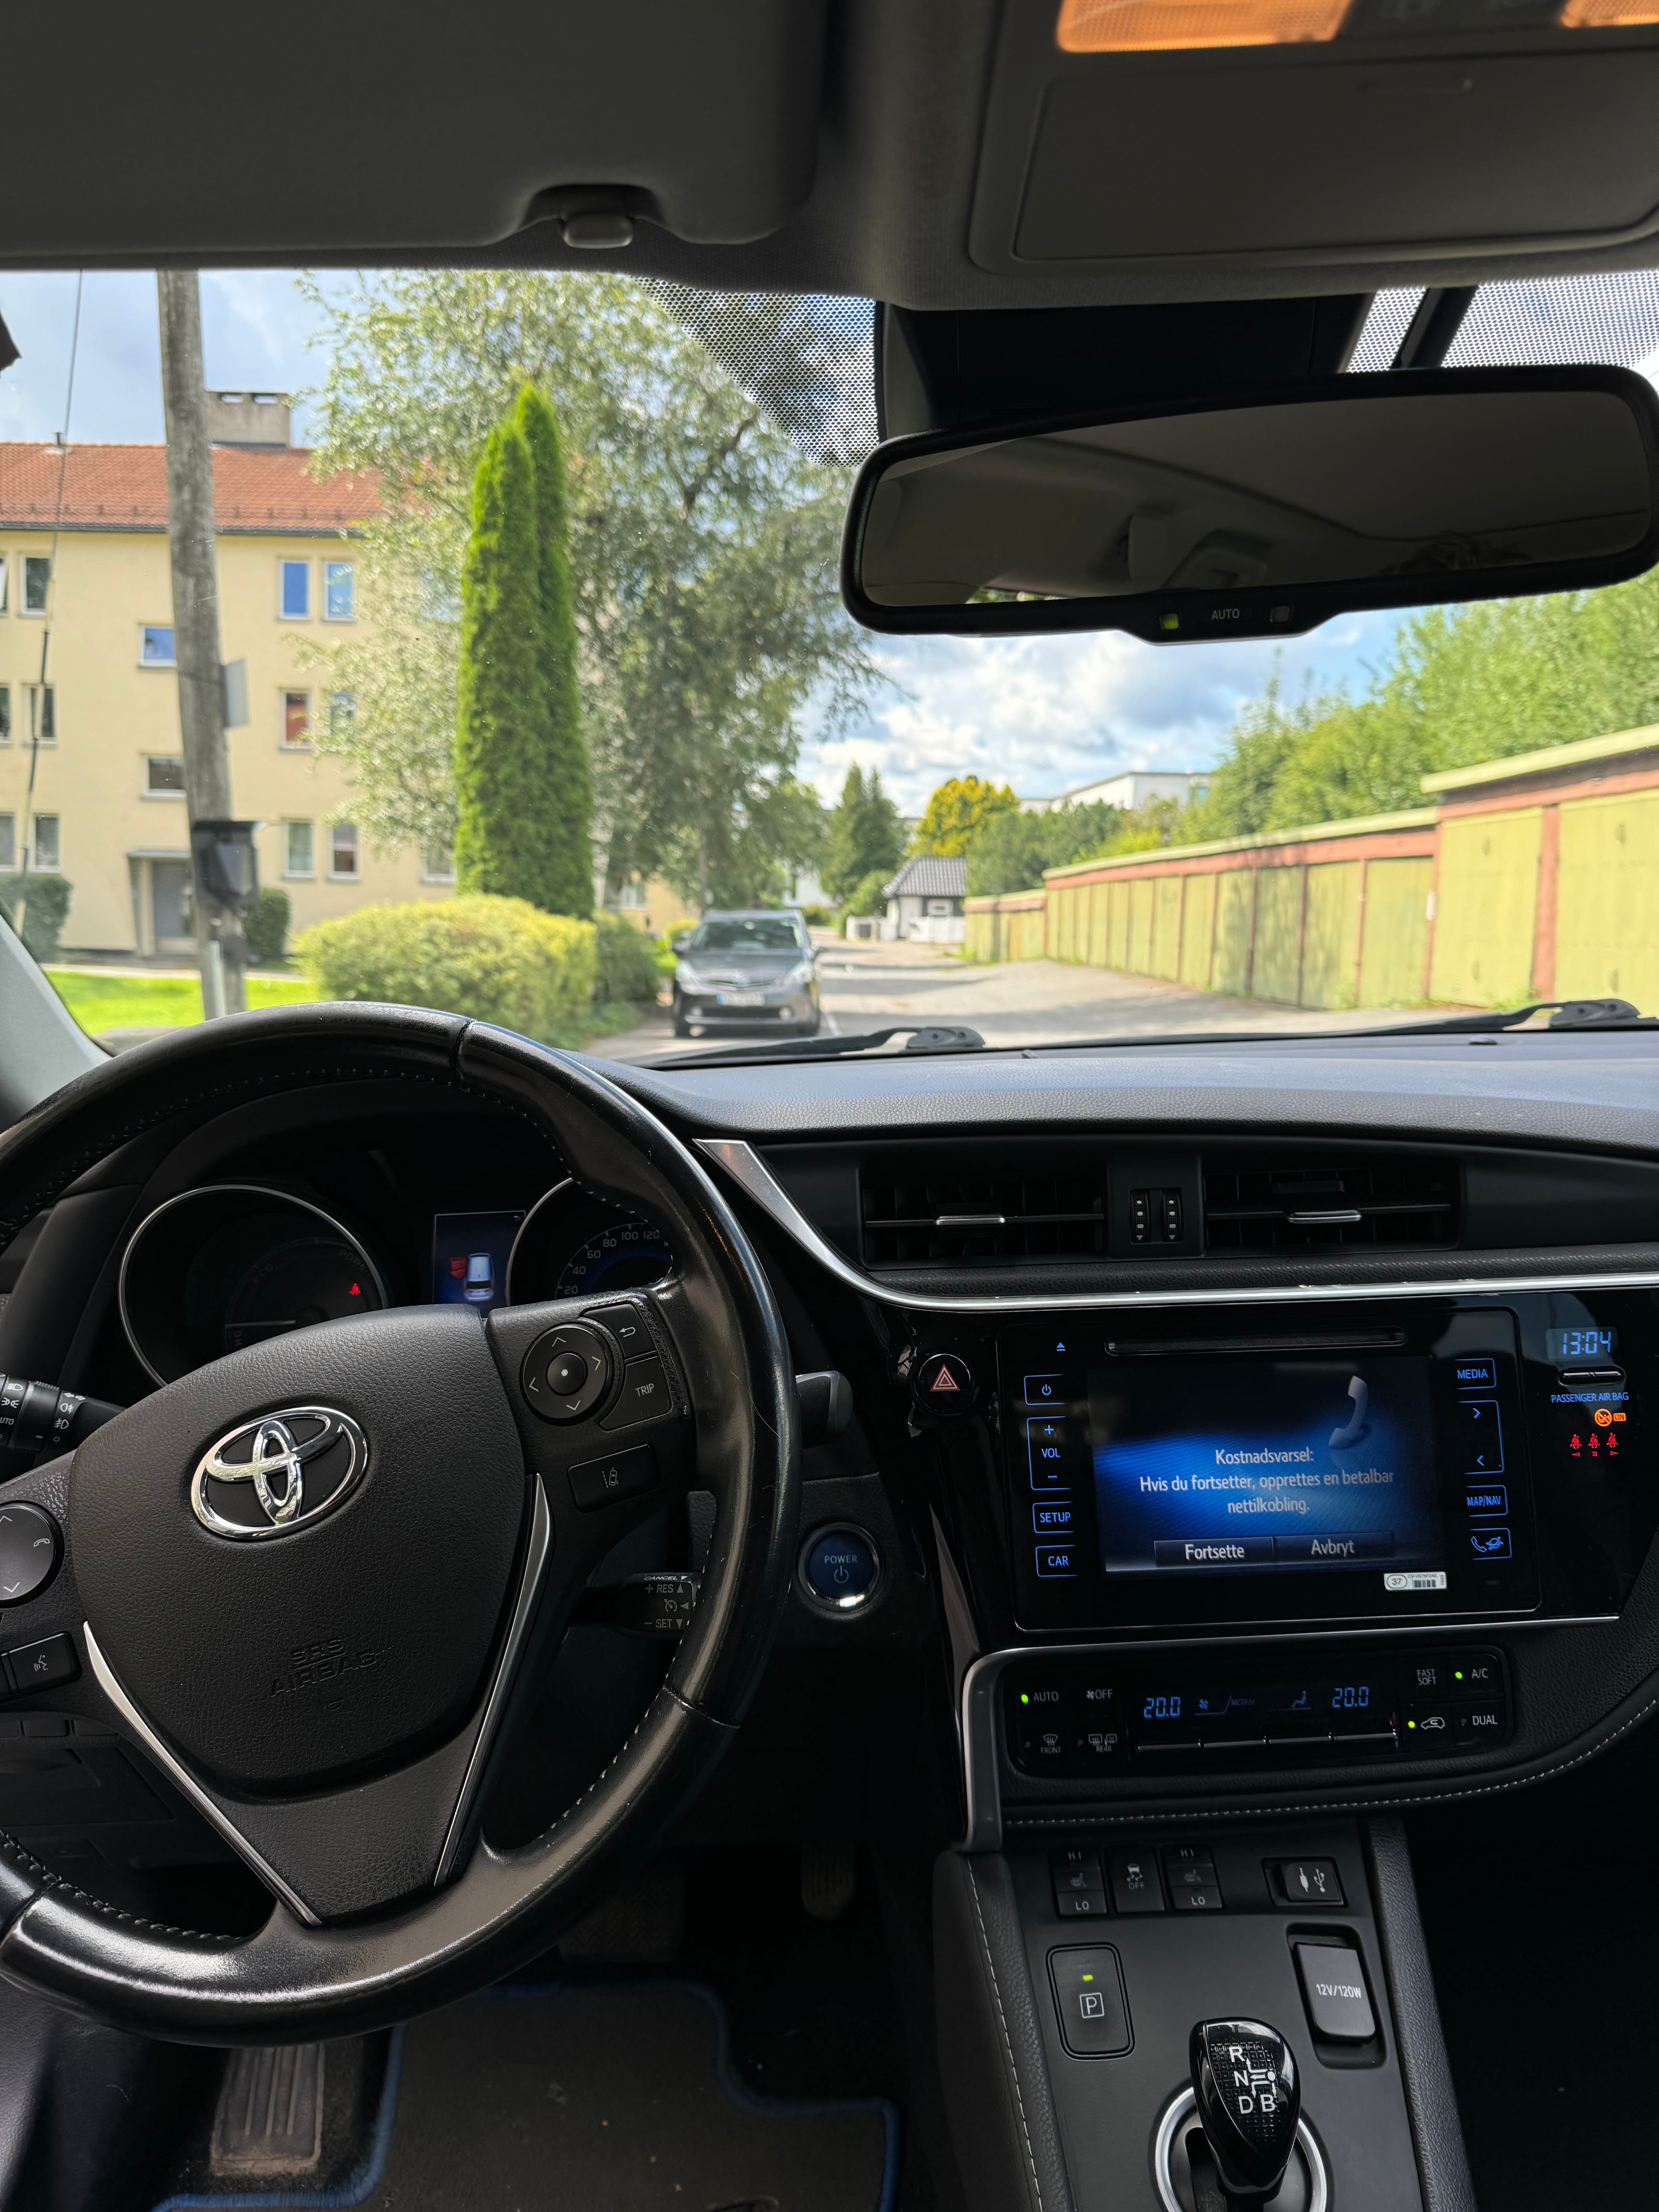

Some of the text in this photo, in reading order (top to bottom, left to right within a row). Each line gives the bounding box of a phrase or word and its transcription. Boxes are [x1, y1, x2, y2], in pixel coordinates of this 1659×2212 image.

[1212, 608, 1240, 620] AUTO
[621, 1231, 639, 1240] 100
[643, 1231, 660, 1240] 120
[603, 1238, 617, 1248] 80
[587, 1250, 601, 1259] 60
[572, 1266, 586, 1275] 40
[564, 1285, 579, 1295] 20
[1563, 1331, 1611, 1355] 13:04
[1457, 1369, 1488, 1379] MEDIA
[635, 1383, 654, 1397] TRIP
[1551, 1392, 1629, 1403] PASSENGER AIR BAG
[0, 1417, 14, 1425] UTO
[1041, 1448, 1060, 1458] VOL
[1215, 1447, 1314, 1465] Kostnadsvarsel:
[1140, 1468, 1393, 1492] Hvis du fortsetter, opprettes en betalbar
[1228, 1496, 1310, 1515] nettilkobling.
[1467, 1495, 1501, 1507] MAP/NAV
[1040, 1512, 1071, 1524] SETUP
[1185, 1543, 1245, 1560] Fortsette
[1311, 1539, 1355, 1556] Avbryt
[824, 1554, 857, 1564] POWER
[1048, 1555, 1069, 1567] CAR
[657, 1584, 673, 1593] RES
[656, 1618, 673, 1628] SET
[291, 1638, 344, 1664] SRS
[270, 1651, 377, 1697] AIRBAG
[1416, 1668, 1436, 1678] FAST
[1472, 1668, 1489, 1680] A/C
[1417, 1676, 1437, 1685] SOFT
[1033, 1691, 1060, 1703] AUTO
[1095, 1688, 1113, 1700] OFF
[1332, 1686, 1370, 1709] 20.0
[1143, 1696, 1182, 1719] 20.0
[1472, 1714, 1498, 1726] DUAL
[1096, 1745, 1113, 1753] REAR
[1067, 1851, 1082, 1860] HI
[1180, 1848, 1195, 1857] HI
[1128, 1882, 1145, 1890] OFF
[1075, 1901, 1090, 1911] LO
[1190, 1896, 1206, 1906] LO
[1316, 1983, 1362, 1999] 12V/120W
[1085, 1997, 1097, 2015] P
[1228, 2046, 1246, 2063] R
[1233, 2069, 1249, 2087] N
[1238, 2094, 1276, 2114] D B
